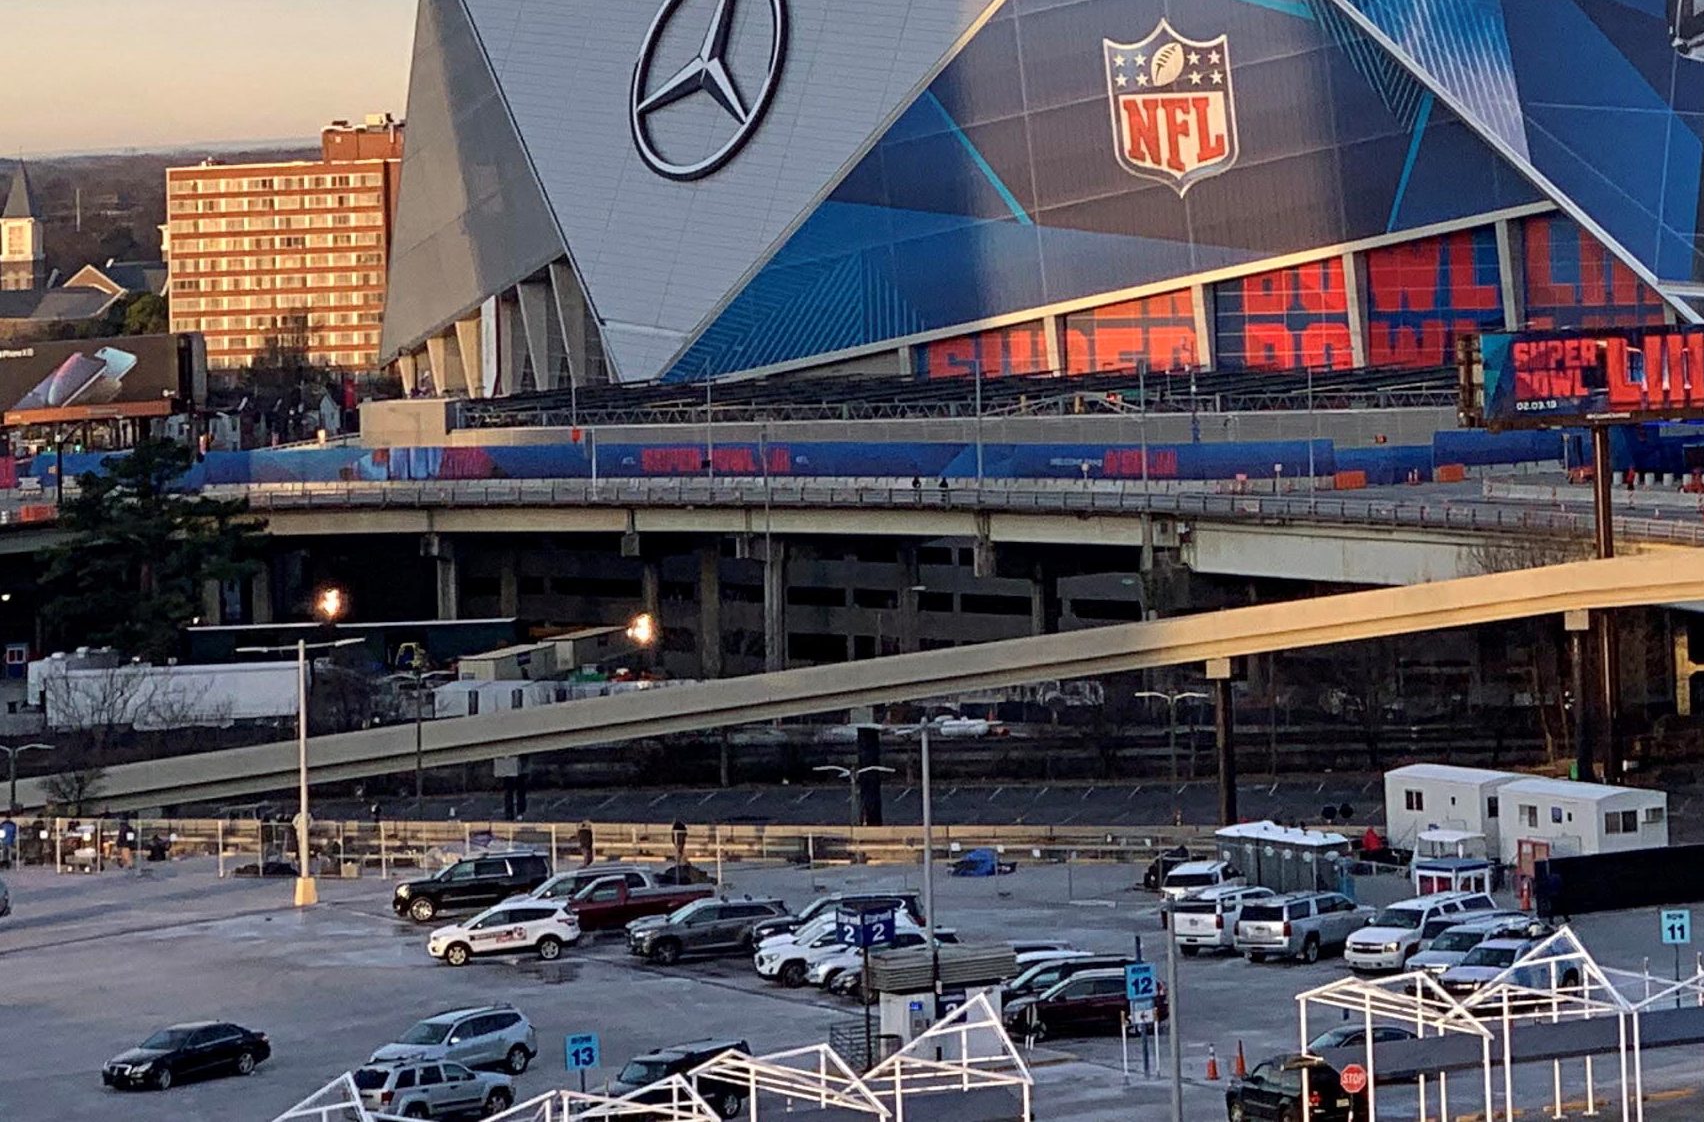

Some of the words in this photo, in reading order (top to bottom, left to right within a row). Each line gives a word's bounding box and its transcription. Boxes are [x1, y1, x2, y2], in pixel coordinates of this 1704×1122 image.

[1122, 96, 1226, 172] NFL
[1512, 337, 1599, 368] SUPER
[1514, 365, 1589, 399] BOWL
[843, 924, 856, 943] 2
[871, 922, 886, 942] 2
[1667, 923, 1685, 940] 11
[1131, 976, 1153, 995] 12
[571, 1046, 595, 1066] 13
[1342, 1072, 1366, 1085] STOP
